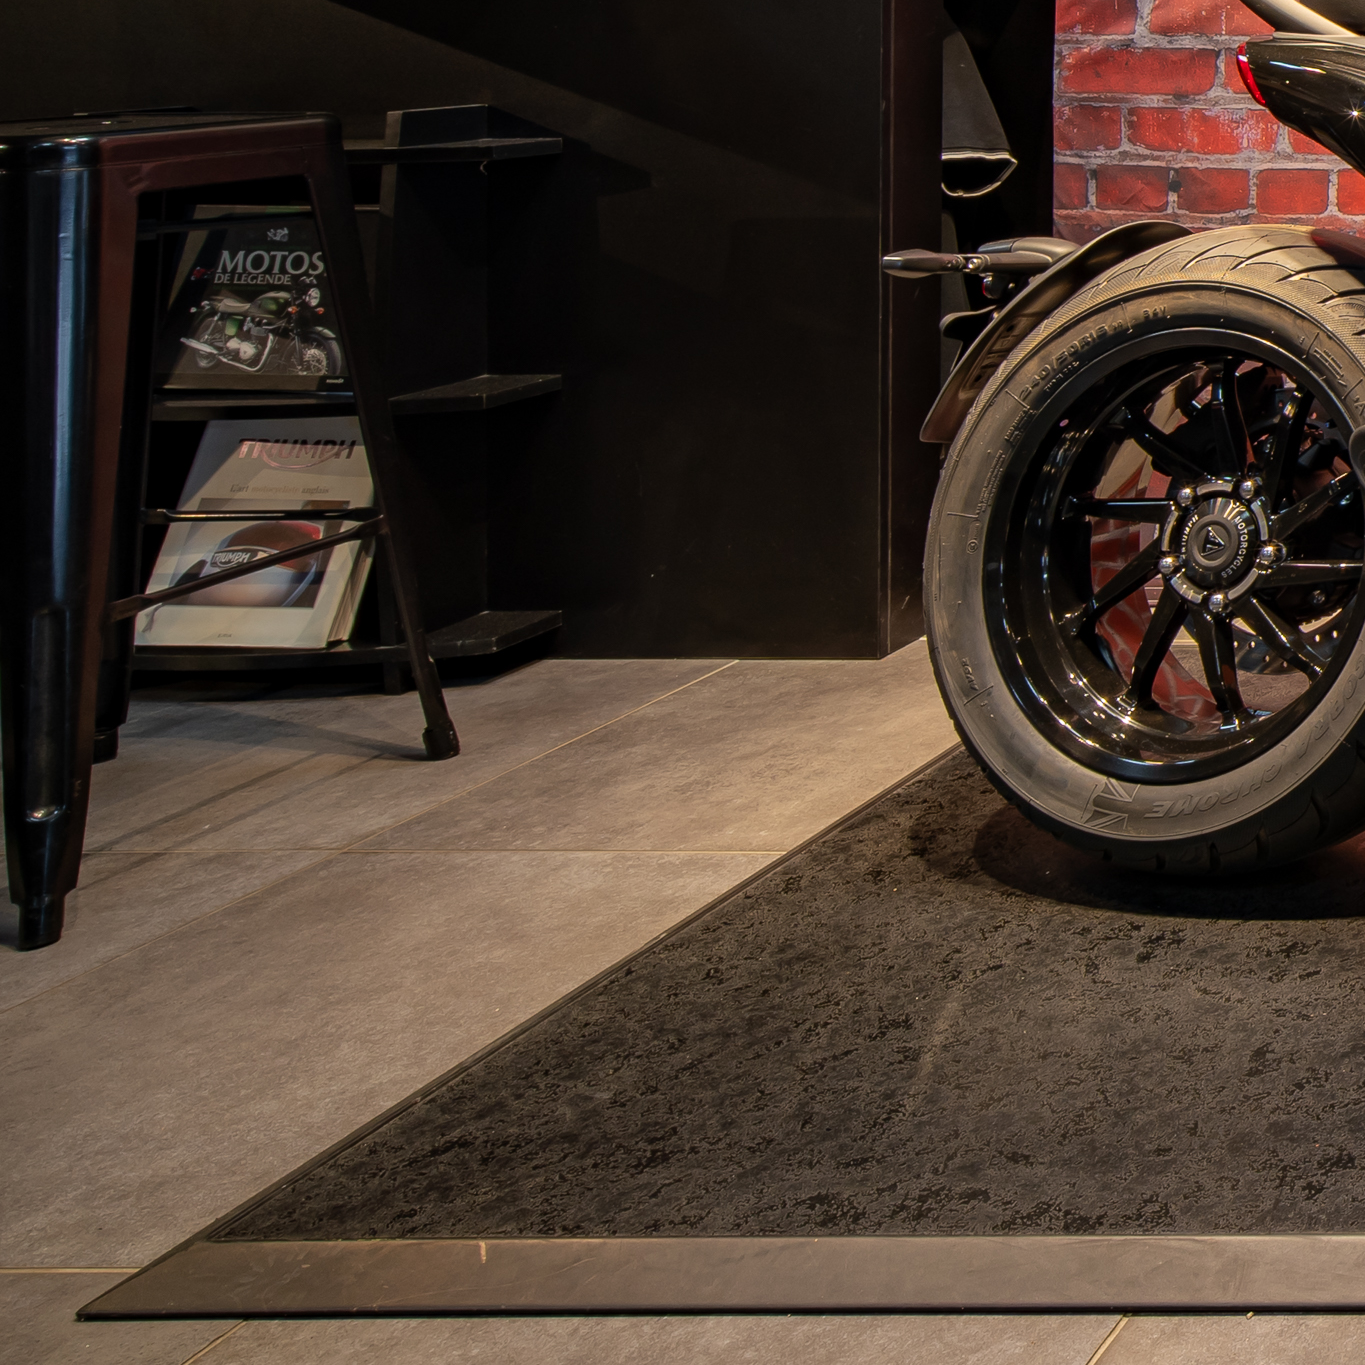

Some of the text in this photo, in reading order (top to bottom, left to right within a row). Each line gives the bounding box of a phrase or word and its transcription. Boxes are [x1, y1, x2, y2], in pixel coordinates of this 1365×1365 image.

[216, 250, 325, 274] MOTOS
[214, 271, 292, 285] DE LÉGENDE
[239, 438, 357, 462] TRIUMPH
[212, 551, 251, 565] TRIUMPH
[1221, 515, 1248, 579] MOTORCYCLES
[1143, 758, 1284, 818] CHROME
